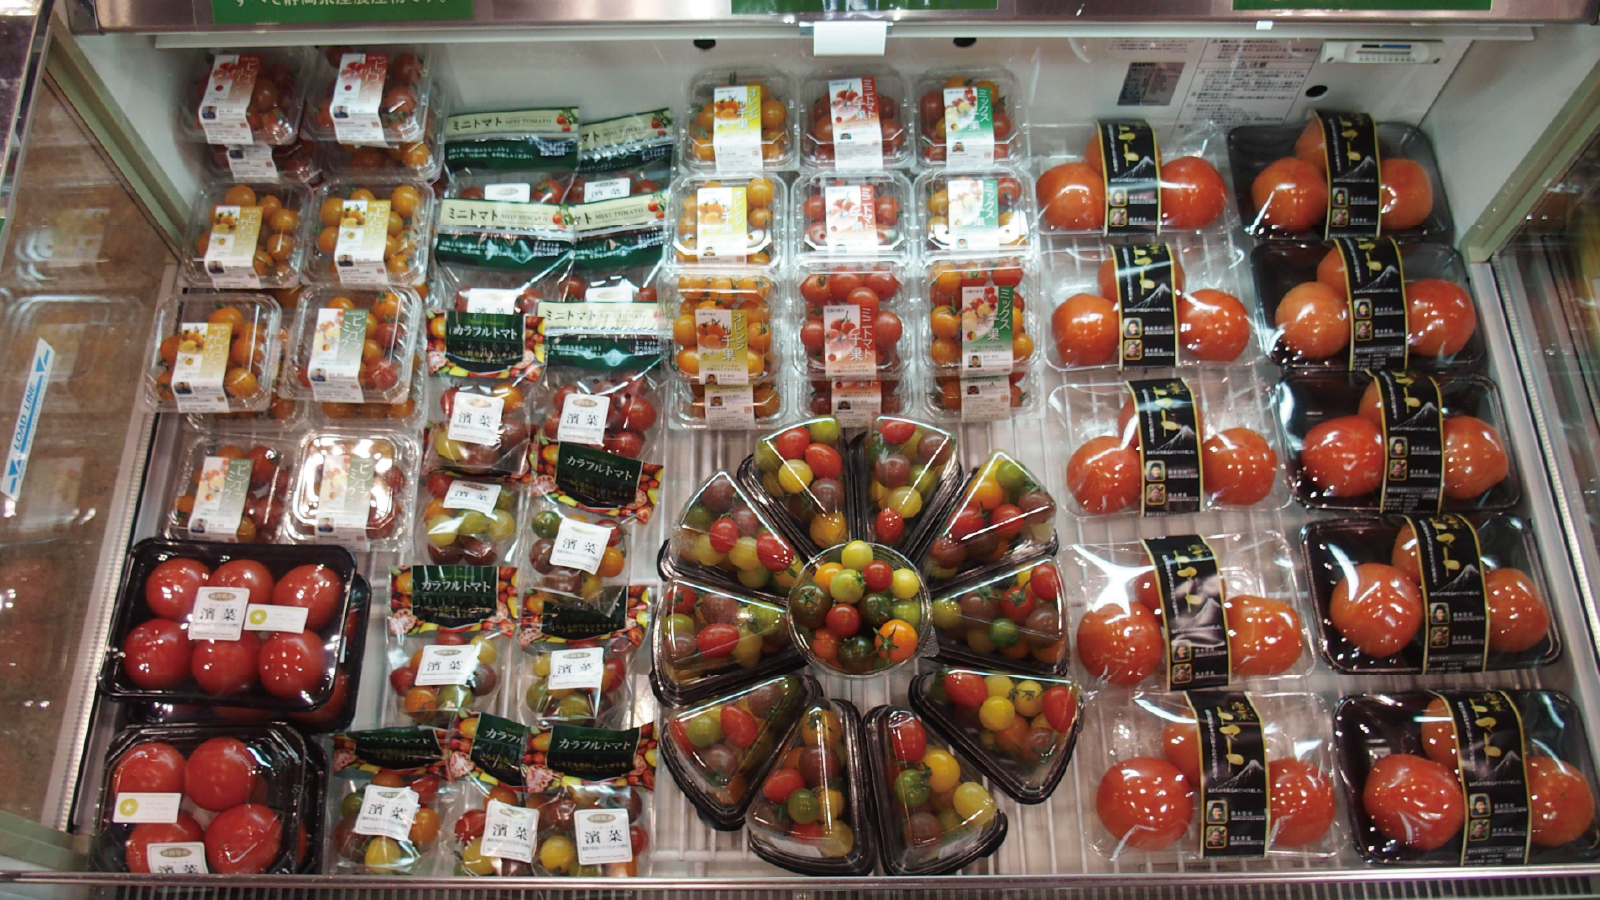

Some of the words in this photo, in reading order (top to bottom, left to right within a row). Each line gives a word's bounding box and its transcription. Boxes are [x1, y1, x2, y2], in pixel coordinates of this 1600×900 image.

[862, 79, 877, 119] ミニトマト
[978, 89, 990, 123] ミックス
[855, 100, 868, 121] 千果
[453, 118, 502, 131] ミニトマト
[861, 187, 875, 231] ミニトマト
[984, 182, 996, 219] ミックス
[448, 207, 499, 221] ミニトマト
[613, 206, 645, 219] TOMATO
[546, 309, 596, 321] ミニトマト
[999, 288, 1011, 330] ミックス
[452, 323, 518, 340] カラフルトマト
[733, 312, 747, 351] オレンジ
[862, 307, 873, 360] ミニトマト
[720, 334, 736, 361] 千果
[850, 332, 863, 361] 千果
[14, 414, 28, 450] LOAD
[25, 382, 36, 413] LINE
[458, 412, 494, 428] 濱菜
[566, 412, 600, 426] 濱菜
[565, 454, 633, 481] カラフルトマト
[421, 580, 492, 593] カラフルトマト
[200, 607, 238, 622] 濱菜
[426, 660, 464, 672] 濱菜
[558, 738, 631, 750] カラフルトマト
[367, 802, 407, 820] 濱菜
[492, 823, 529, 841] 濱菜
[585, 829, 623, 844] 濱菜
